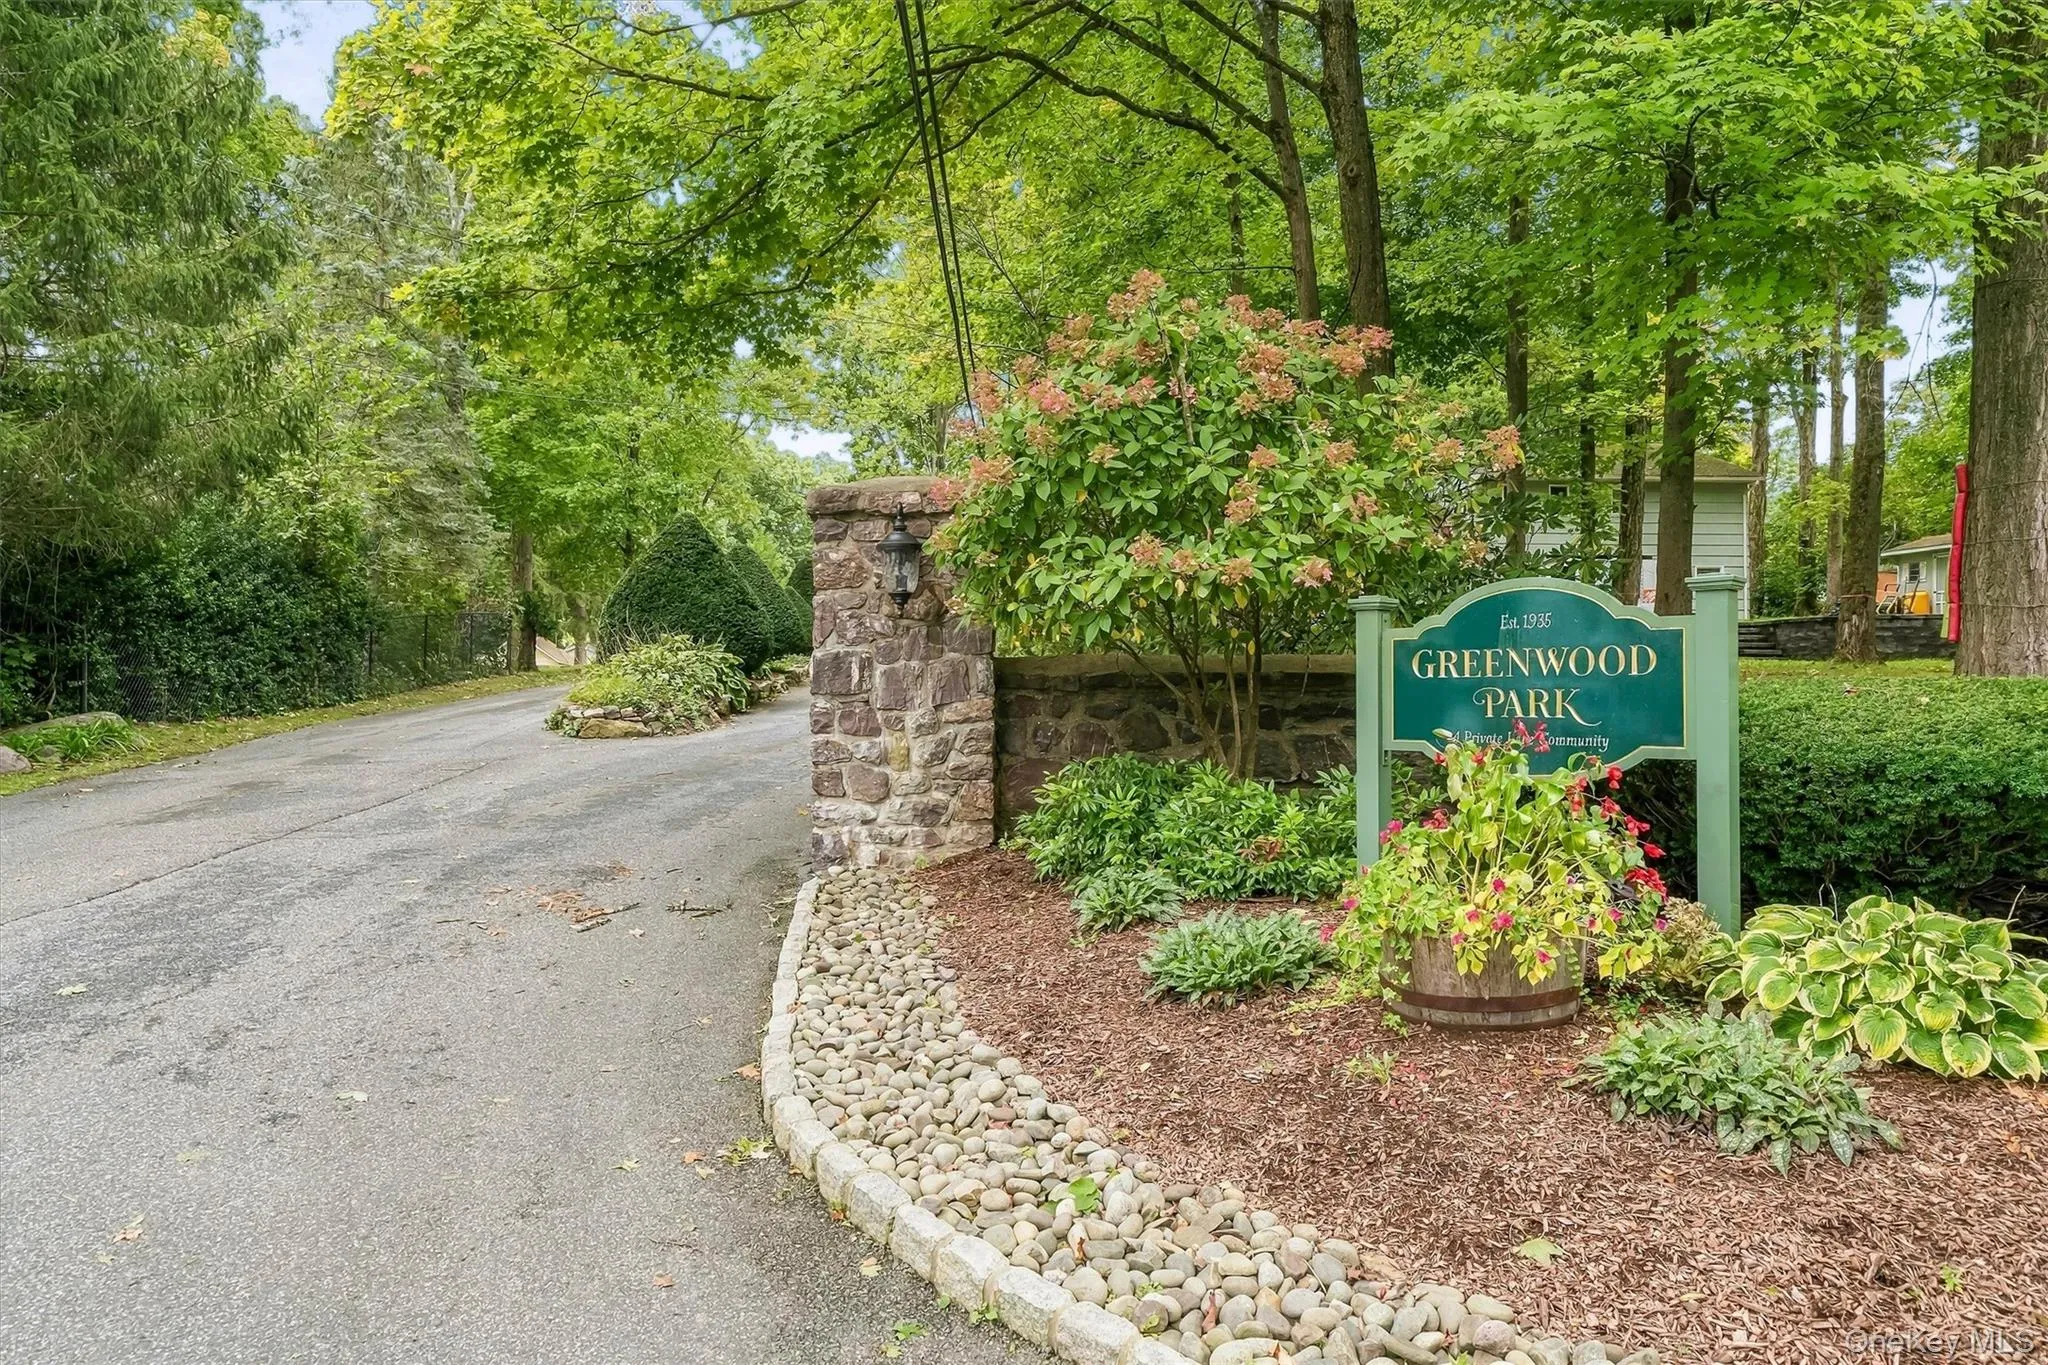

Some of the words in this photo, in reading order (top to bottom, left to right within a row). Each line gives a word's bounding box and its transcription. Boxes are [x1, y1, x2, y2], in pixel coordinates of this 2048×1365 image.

[1500, 613, 1520, 630] Est.
[1523, 611, 1552, 629] 1935
[1411, 644, 1658, 680] GREENWOOD
[1472, 686, 1603, 727] PARK
[1464, 730, 1504, 745] Private
[1543, 731, 1610, 753] ommunity
